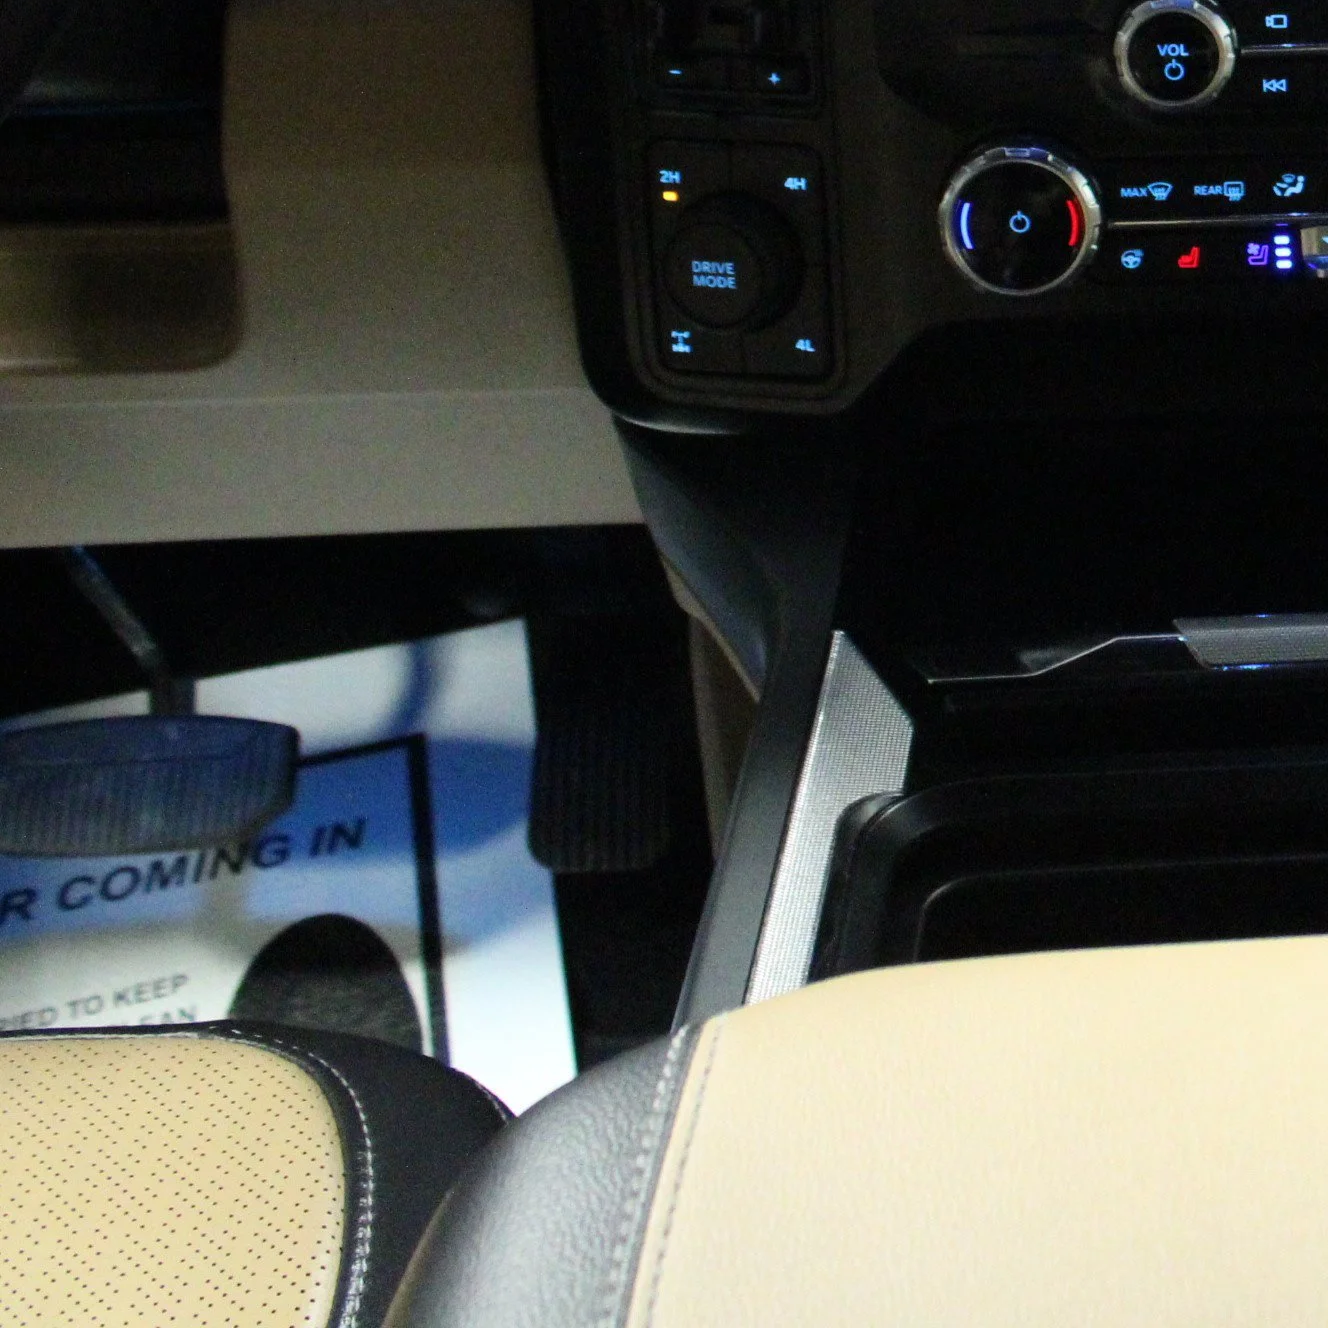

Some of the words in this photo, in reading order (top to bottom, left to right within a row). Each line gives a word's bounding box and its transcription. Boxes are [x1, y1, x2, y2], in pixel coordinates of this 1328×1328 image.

[1157, 43, 1189, 57] VOL
[659, 170, 681, 184] 2H
[784, 177, 807, 191] 4H
[1120, 187, 1148, 198] MAX
[1193, 185, 1224, 196] REAR
[691, 260, 735, 274] DRIVE
[692, 275, 736, 289] MODE
[795, 339, 815, 352] 4L
[57, 833, 292, 912] COMING
[308, 817, 368, 856] IN
[67, 995, 104, 1019] TO
[113, 974, 190, 1006] KEEP
